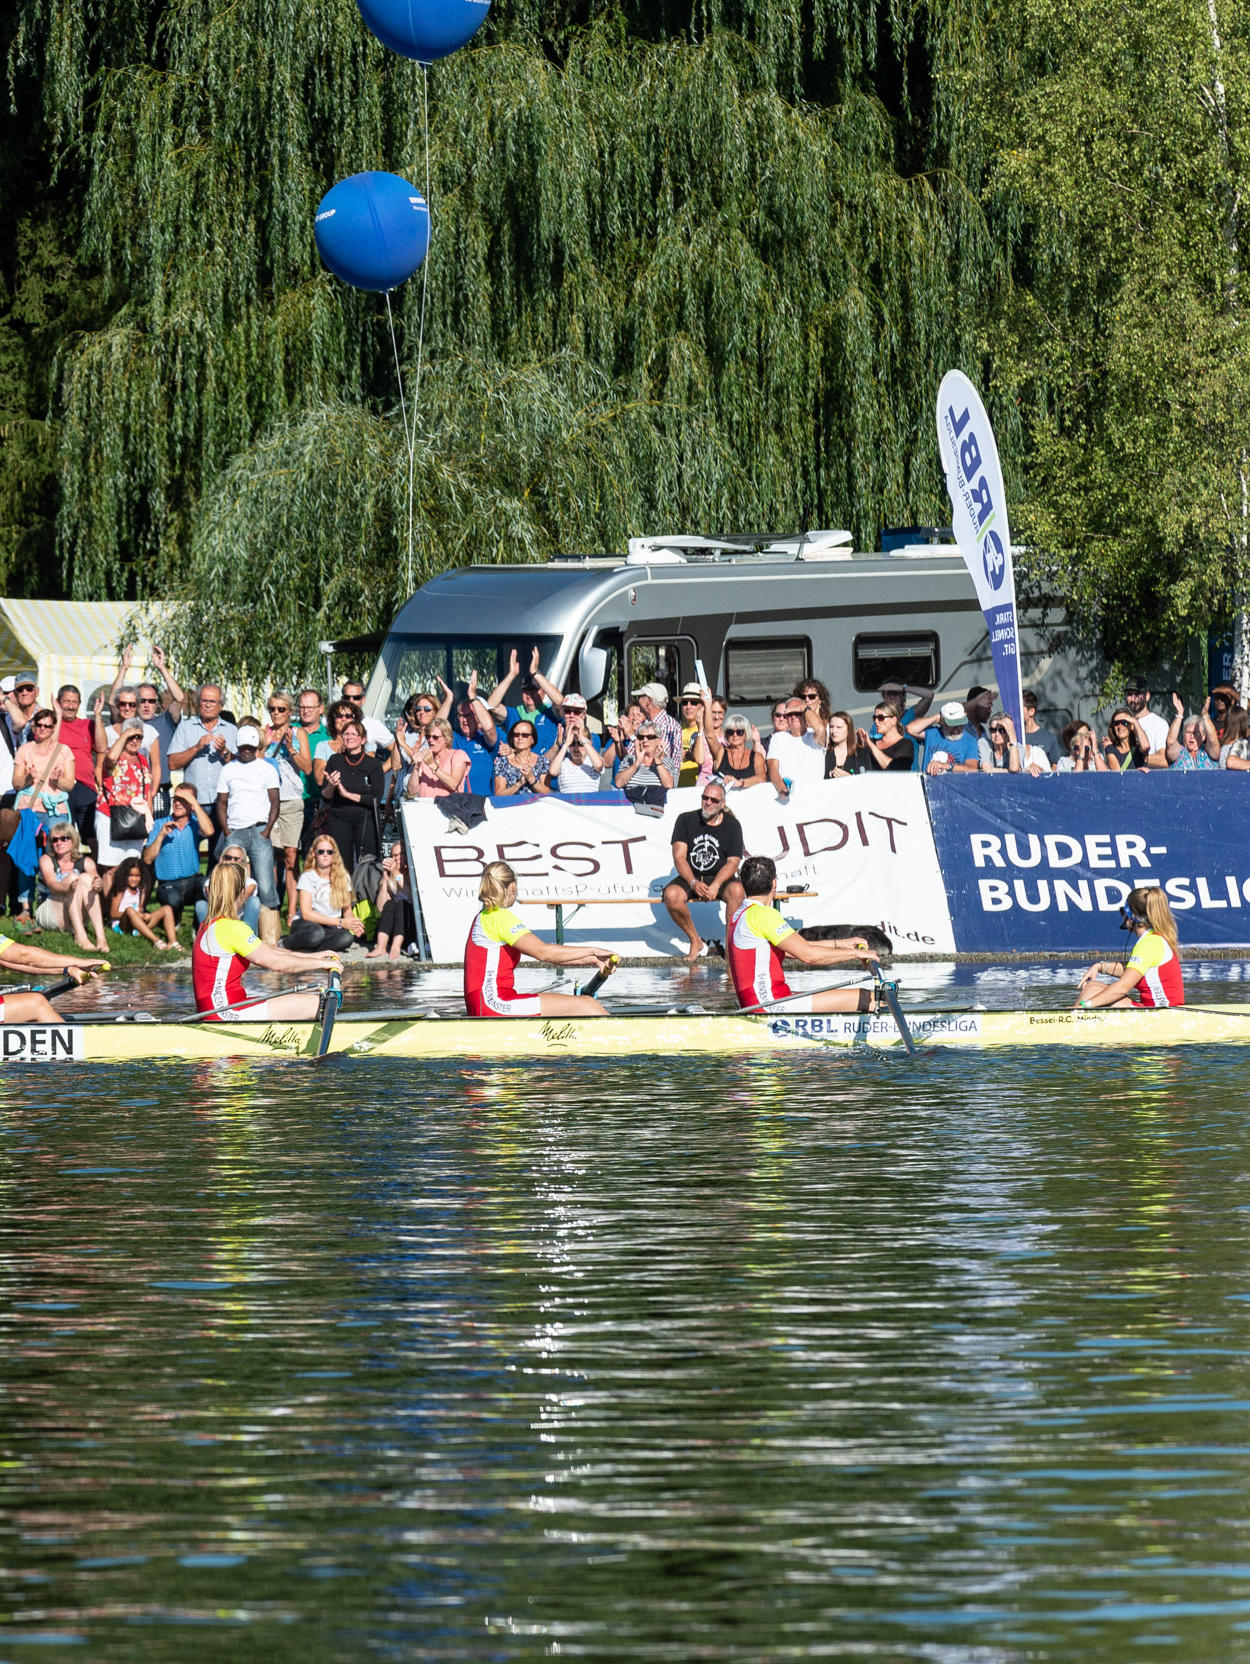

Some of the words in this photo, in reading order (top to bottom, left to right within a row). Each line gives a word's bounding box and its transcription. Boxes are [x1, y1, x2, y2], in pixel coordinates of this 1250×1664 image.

[434, 835, 647, 878] BEST
[742, 811, 908, 862] UDIT
[970, 833, 1167, 868] RUDER-
[257, 1024, 302, 1046] Melitta
[795, 1019, 838, 1033] RBL
[844, 1020, 978, 1034] RUDER-BNDESLIGA
